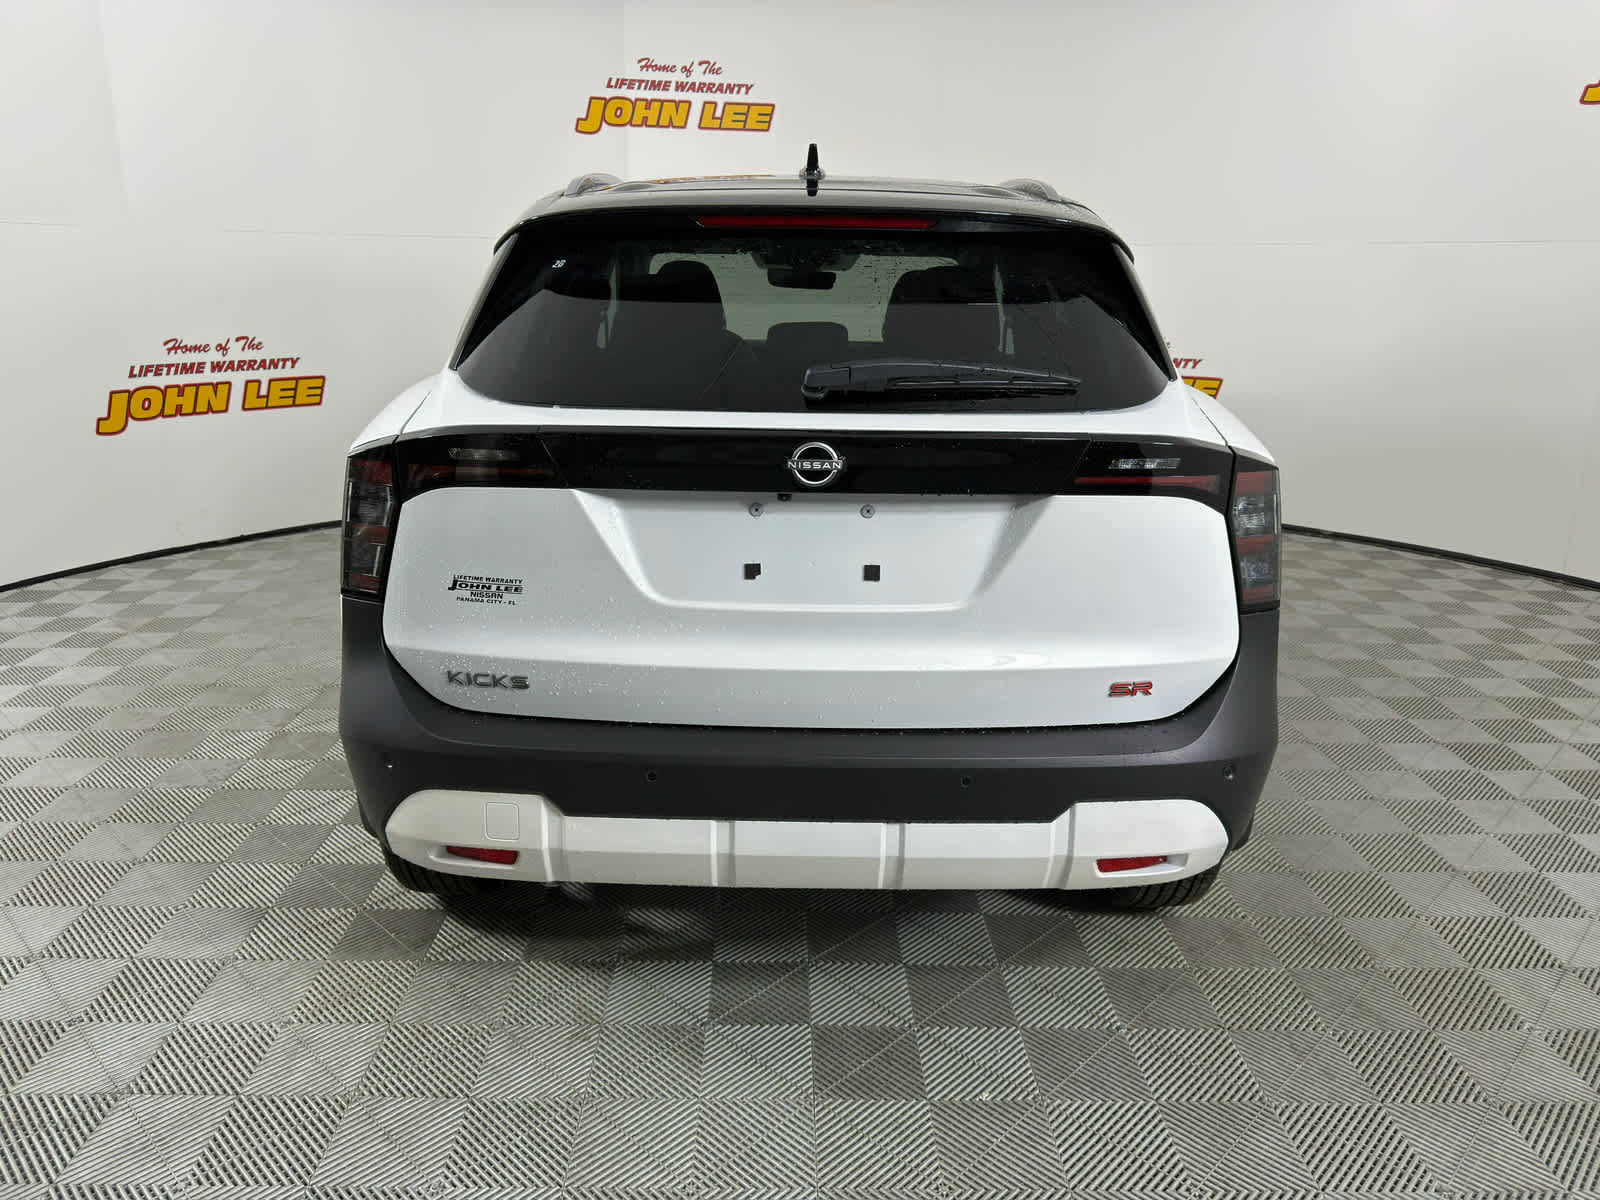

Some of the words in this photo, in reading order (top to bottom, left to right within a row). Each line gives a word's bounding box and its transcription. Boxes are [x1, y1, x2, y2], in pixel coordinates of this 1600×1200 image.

[637, 57, 677, 73] Home
[680, 61, 695, 78] of
[698, 60, 723, 76] The
[606, 77, 672, 92] LIFETIME
[674, 80, 754, 95] WARRANTY
[575, 96, 692, 134] JOHN
[698, 101, 775, 132] LEE
[163, 338, 210, 356] Home
[215, 338, 231, 357] of
[235, 336, 264, 352] The
[128, 361, 206, 378] LIFETIME
[210, 357, 300, 374] WARRANTY
[96, 381, 232, 436] JOHN
[242, 375, 325, 411] LEE
[787, 461, 841, 470] NISSAN
[448, 577, 492, 591] JOHN
[496, 584, 523, 593] LEE
[454, 574, 484, 582] LIFETIME
[485, 576, 523, 584] WARRANTY
[456, 596, 485, 604] PANAMA
[470, 591, 504, 599] NISSAN
[446, 670, 530, 690] KICKS
[1108, 681, 1153, 698] SR
